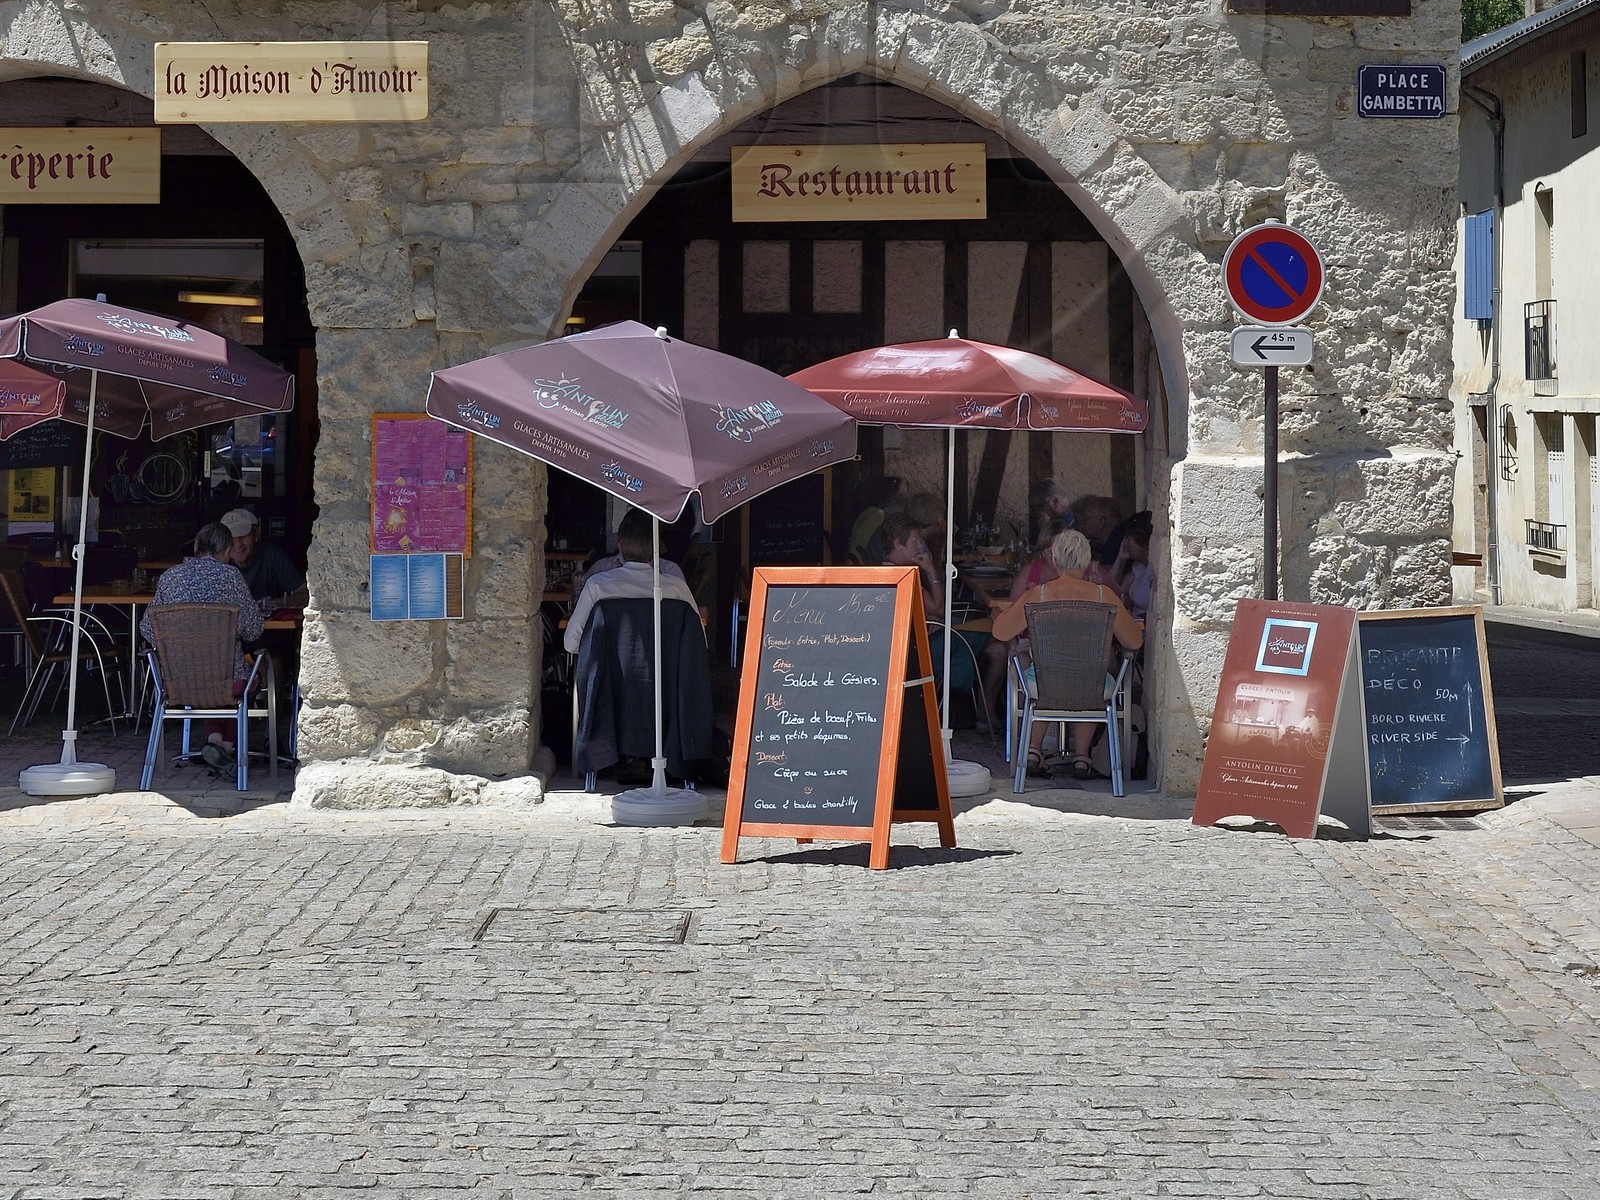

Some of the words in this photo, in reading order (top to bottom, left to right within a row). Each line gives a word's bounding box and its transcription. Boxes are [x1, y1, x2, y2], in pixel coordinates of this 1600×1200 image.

[166, 60, 187, 95] la
[196, 63, 290, 99] Maison
[310, 61, 418, 95] d'Amour
[1378, 73, 1429, 88] PLACE
[1362, 95, 1443, 110] GAMBETTA
[757, 162, 958, 198] Restaurant
[1271, 333, 1284, 342] 45
[117, 344, 146, 358] GLACES
[148, 350, 195, 368] ARTISANALES
[160, 363, 174, 371] 1916
[534, 379, 629, 422] ANTOLIN
[842, 392, 872, 406] Glaces
[877, 392, 931, 405] Artisanales
[513, 420, 542, 439] GLACES
[543, 433, 591, 460] ARTISANALES
[531, 438, 552, 451] DEPUIS
[553, 447, 567, 458] 1916
[773, 590, 826, 625] Menu
[1368, 647, 1462, 665] BROCANTE
[782, 672, 819, 687] Salade
[823, 671, 835, 686] de
[1366, 672, 1422, 690] DÉCO
[1265, 687, 1291, 695] ANTOLIN
[810, 711, 821, 723] de
[1371, 714, 1405, 725] BORD
[755, 731, 764, 742] et
[769, 733, 781, 741] ses
[785, 730, 809, 744] petits
[1371, 733, 1411, 745] RIVER
[1414, 731, 1439, 743] SIDE
[823, 769, 849, 777] sucre
[1225, 760, 1261, 770] ANTOLIN
[1264, 765, 1297, 775] DELICES
[754, 799, 777, 809] Glace
[822, 796, 858, 813] chantilly
